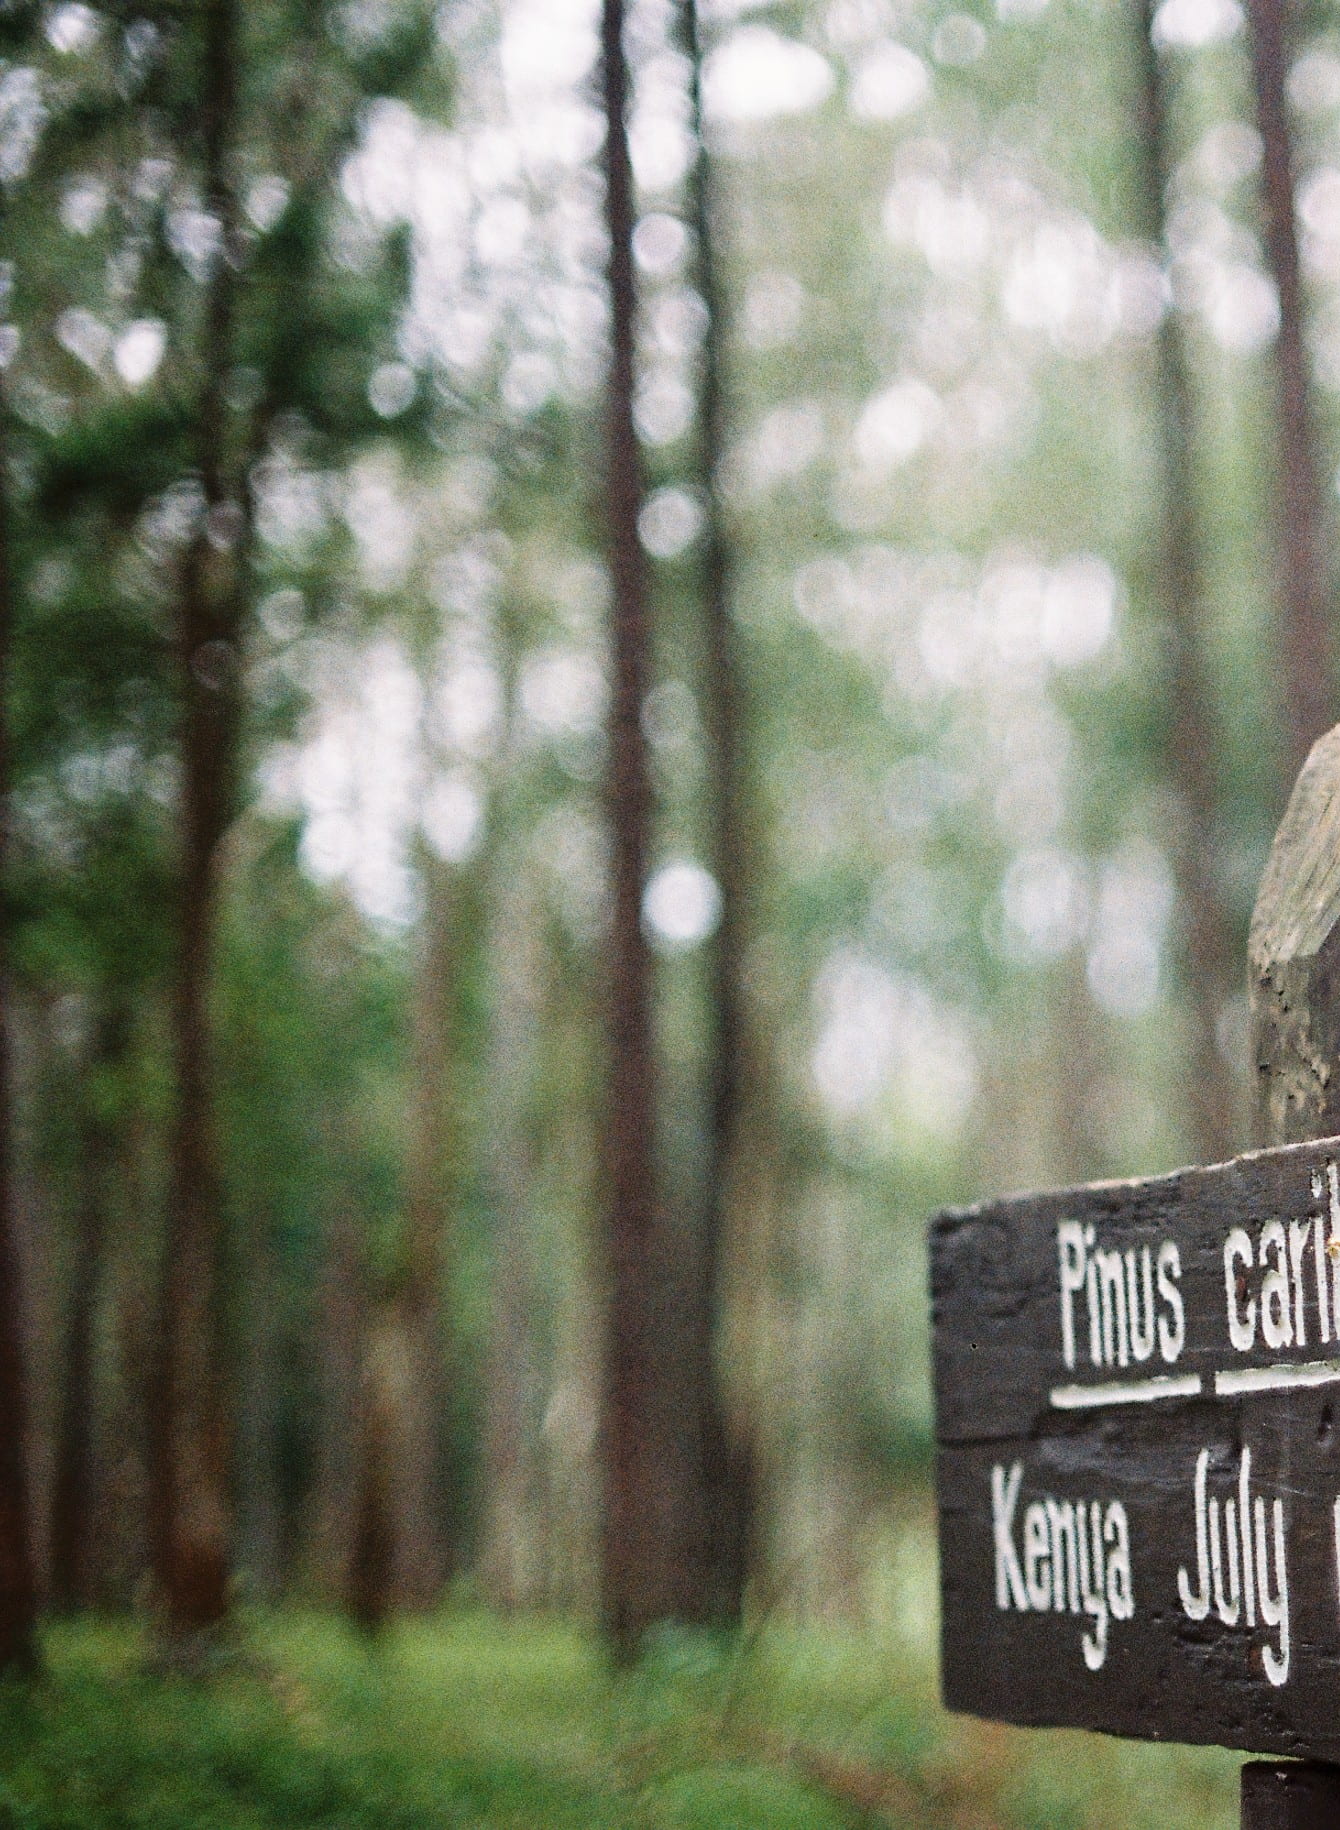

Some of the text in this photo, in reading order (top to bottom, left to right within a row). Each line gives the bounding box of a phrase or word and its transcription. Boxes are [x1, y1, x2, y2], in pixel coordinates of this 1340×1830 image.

[1057, 1219, 1187, 1371] Pinus
[991, 1461, 1134, 1671] Kenya
[1177, 1446, 1290, 1687] July
